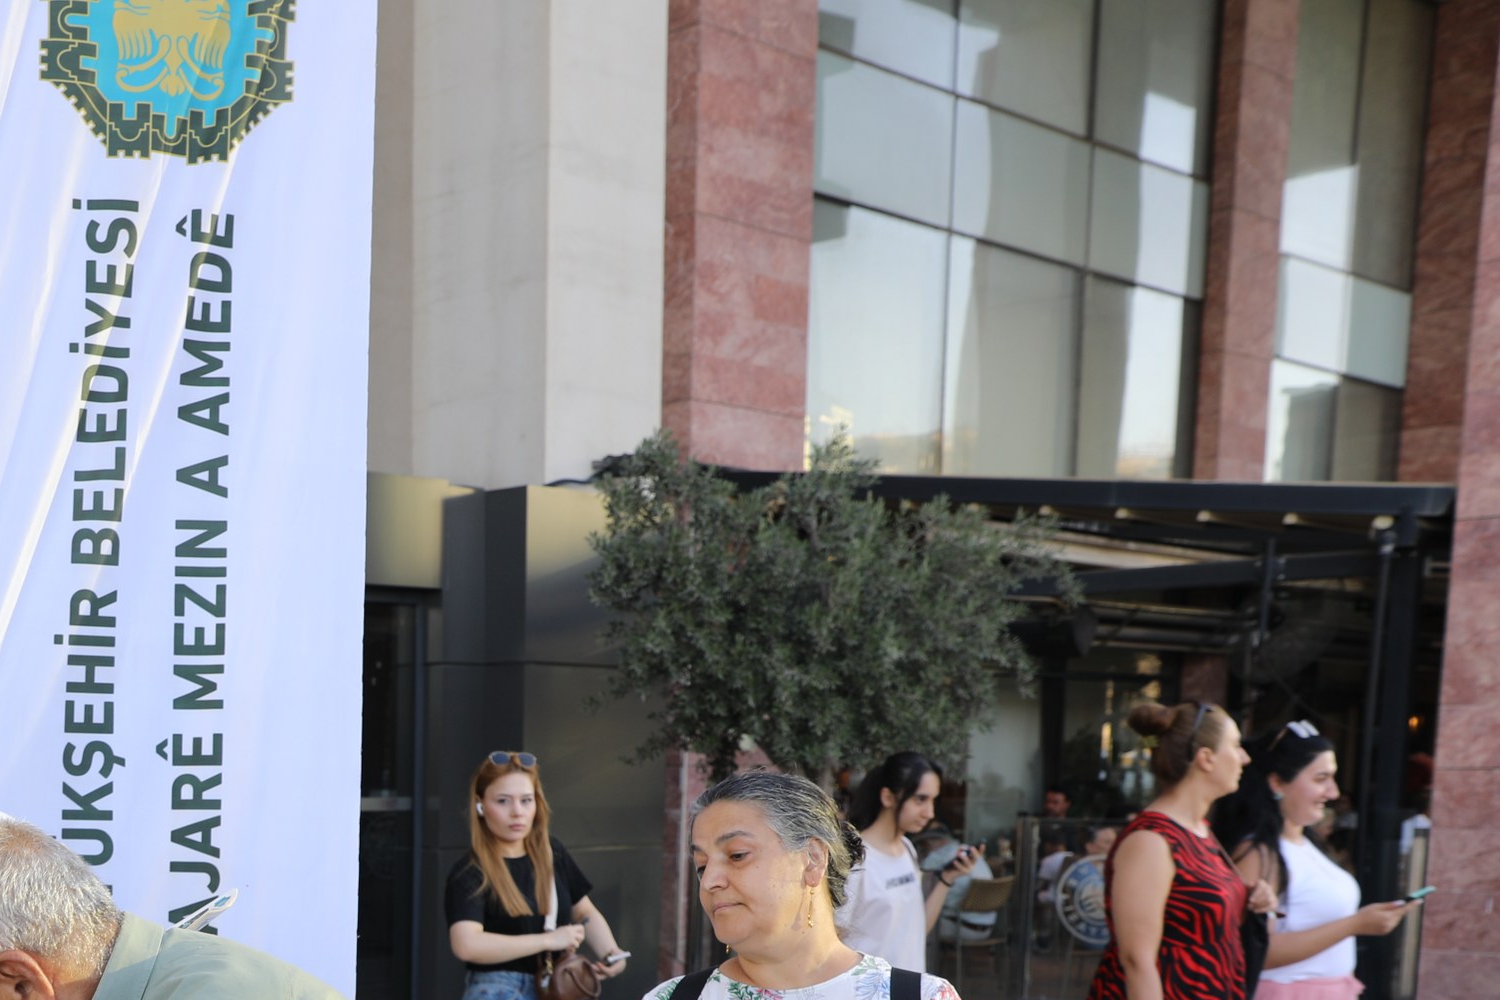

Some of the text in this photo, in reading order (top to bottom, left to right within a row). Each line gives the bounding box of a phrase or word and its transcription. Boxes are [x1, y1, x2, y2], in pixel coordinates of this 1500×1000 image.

[69, 198, 139, 566] BELEDİYESİ
[175, 208, 235, 436] AMEDÊ
[175, 454, 229, 499] A
[172, 519, 228, 710] MEZIN
